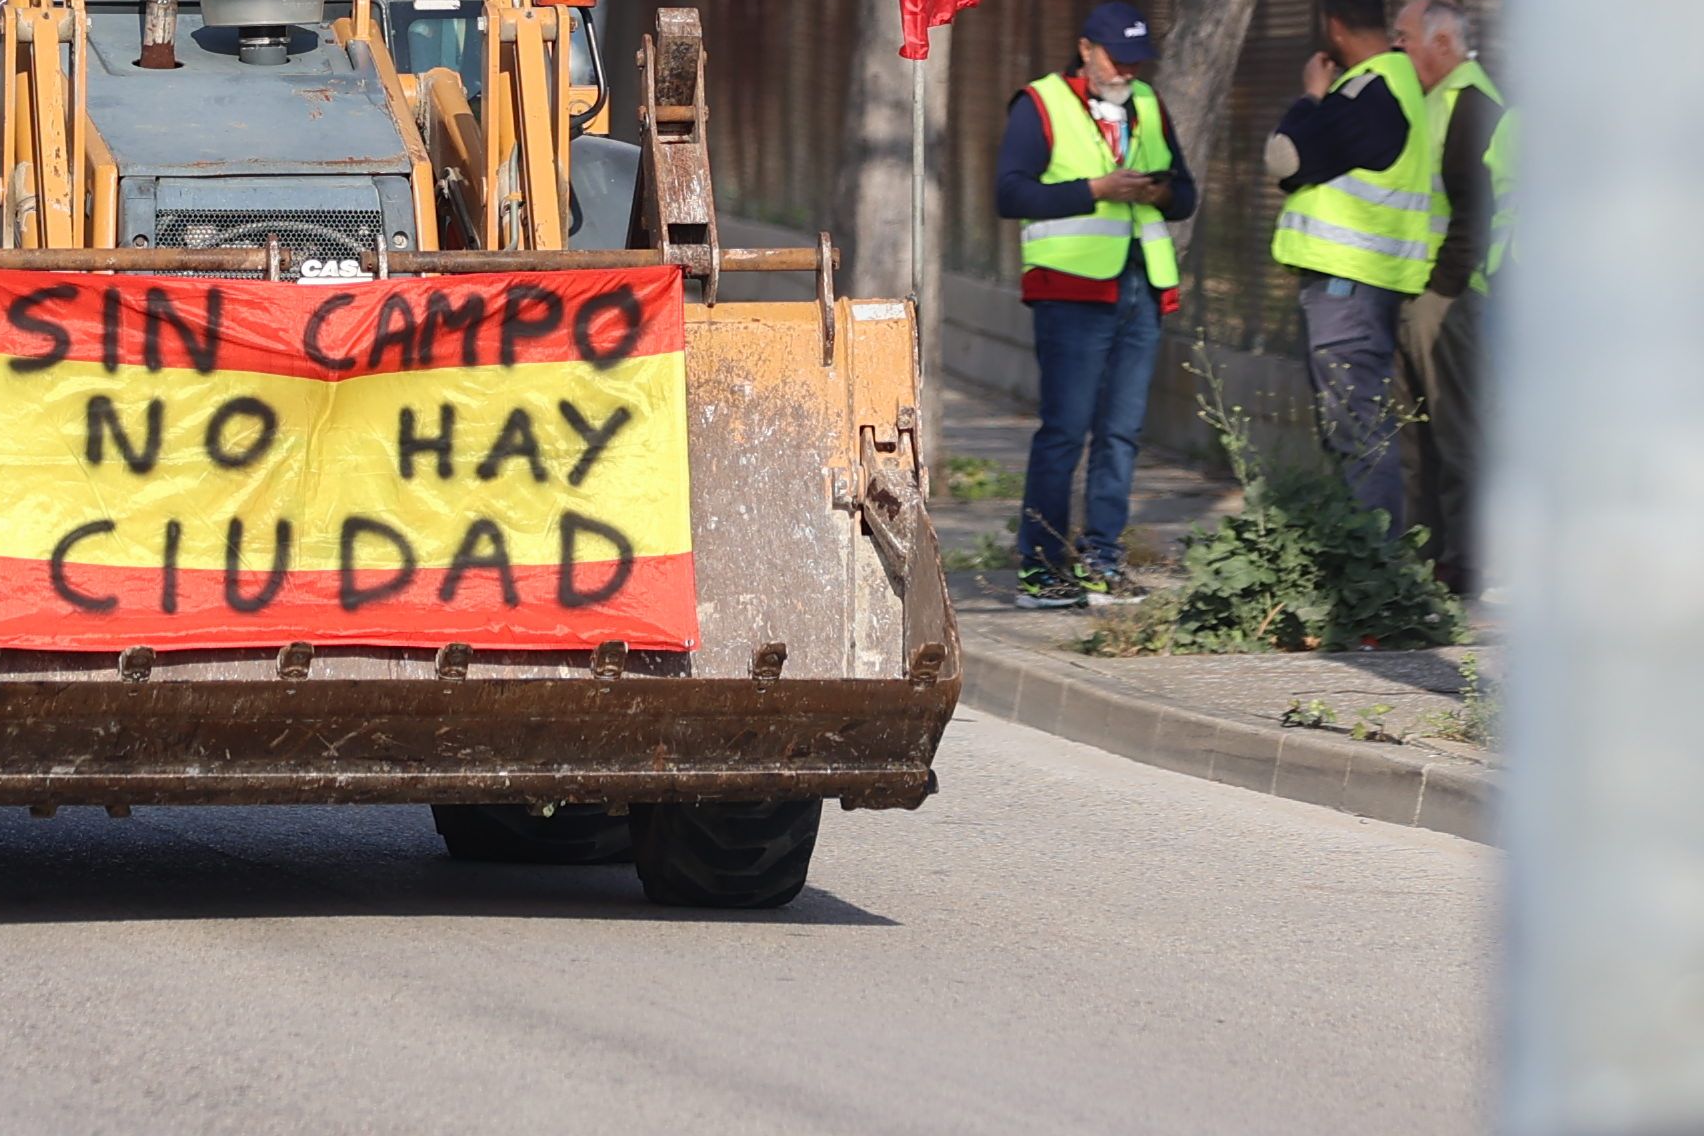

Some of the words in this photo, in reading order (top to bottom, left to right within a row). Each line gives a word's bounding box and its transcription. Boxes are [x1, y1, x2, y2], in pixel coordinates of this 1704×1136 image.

[6, 284, 223, 375] SIN
[302, 284, 643, 370] CAMPO
[84, 395, 277, 475] NO
[397, 400, 631, 486] HAY
[50, 511, 634, 614] CIUDAD
